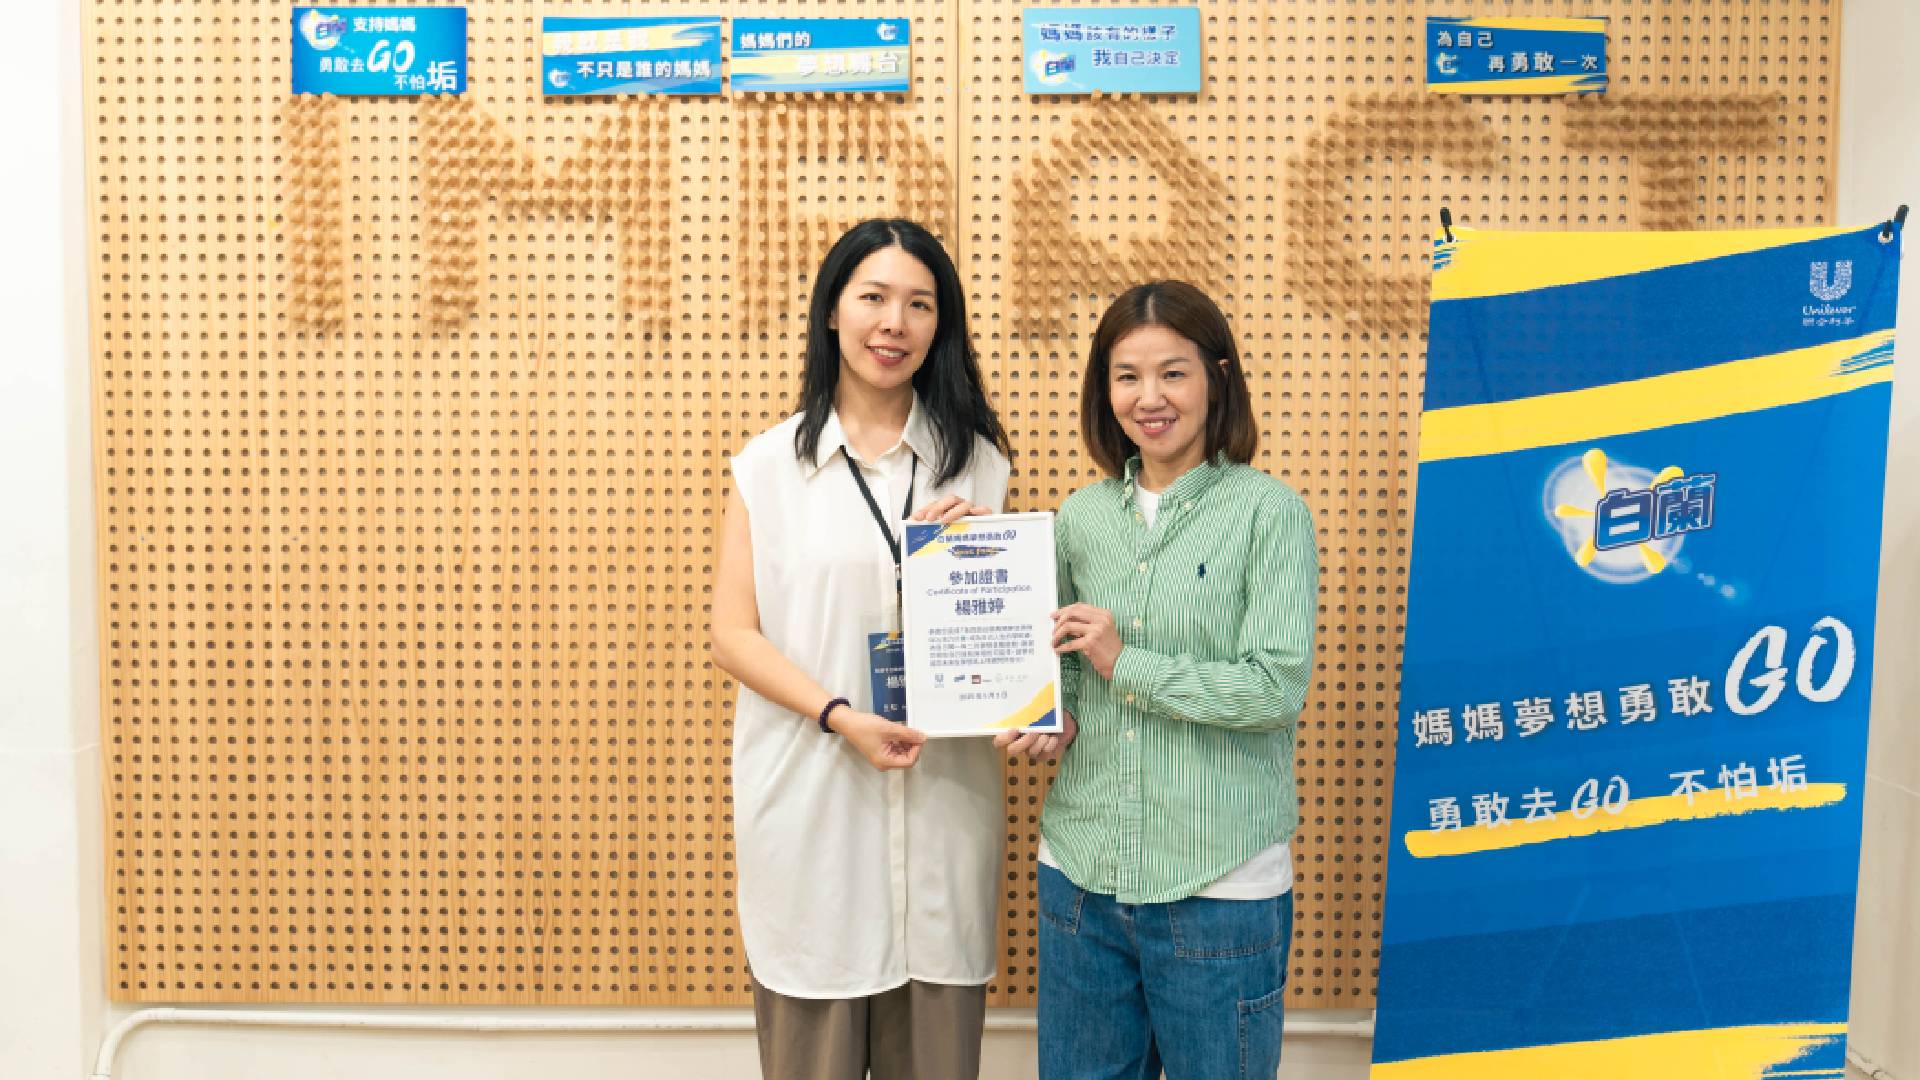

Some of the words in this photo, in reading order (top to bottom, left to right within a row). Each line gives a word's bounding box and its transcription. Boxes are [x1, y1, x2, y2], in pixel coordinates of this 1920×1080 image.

[1437, 30, 1494, 48] 為自己
[1092, 48, 1179, 67] 我自己決定
[1488, 51, 1598, 73] 再勇敢一次
[395, 61, 457, 91] 不怕垢
[576, 60, 712, 79] 不只是誰的媽媽
[1594, 473, 1719, 551] 白蘭
[949, 568, 1008, 585] 參加證書
[1669, 753, 1809, 806] 不怕垢
